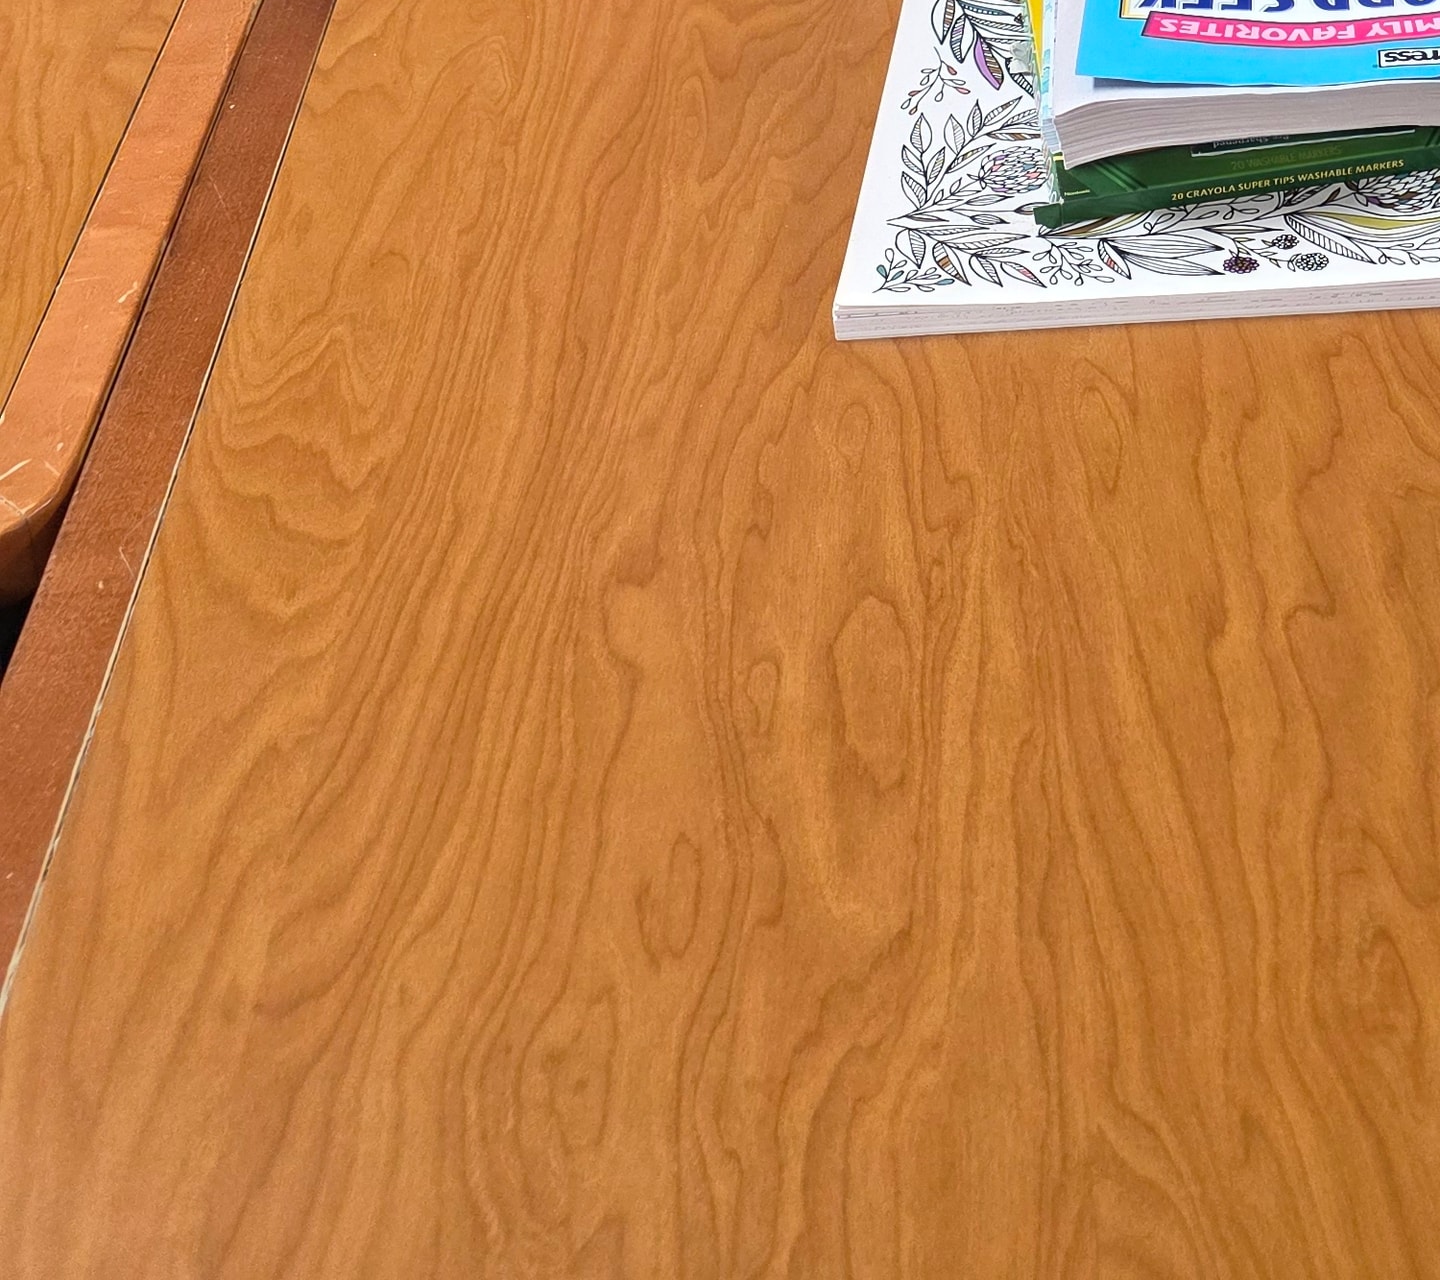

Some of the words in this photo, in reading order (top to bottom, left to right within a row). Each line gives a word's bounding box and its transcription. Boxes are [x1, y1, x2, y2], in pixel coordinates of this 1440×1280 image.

[1159, 18, 1355, 42] FAVORITES
[1171, 192, 1184, 201] 20
[1186, 184, 1236, 199] CRAYOLA
[1238, 179, 1271, 191] SUPER
[1272, 176, 1295, 186] TIPS
[1297, 167, 1353, 182] WASHABLE
[1355, 159, 1404, 173] MARKERS
